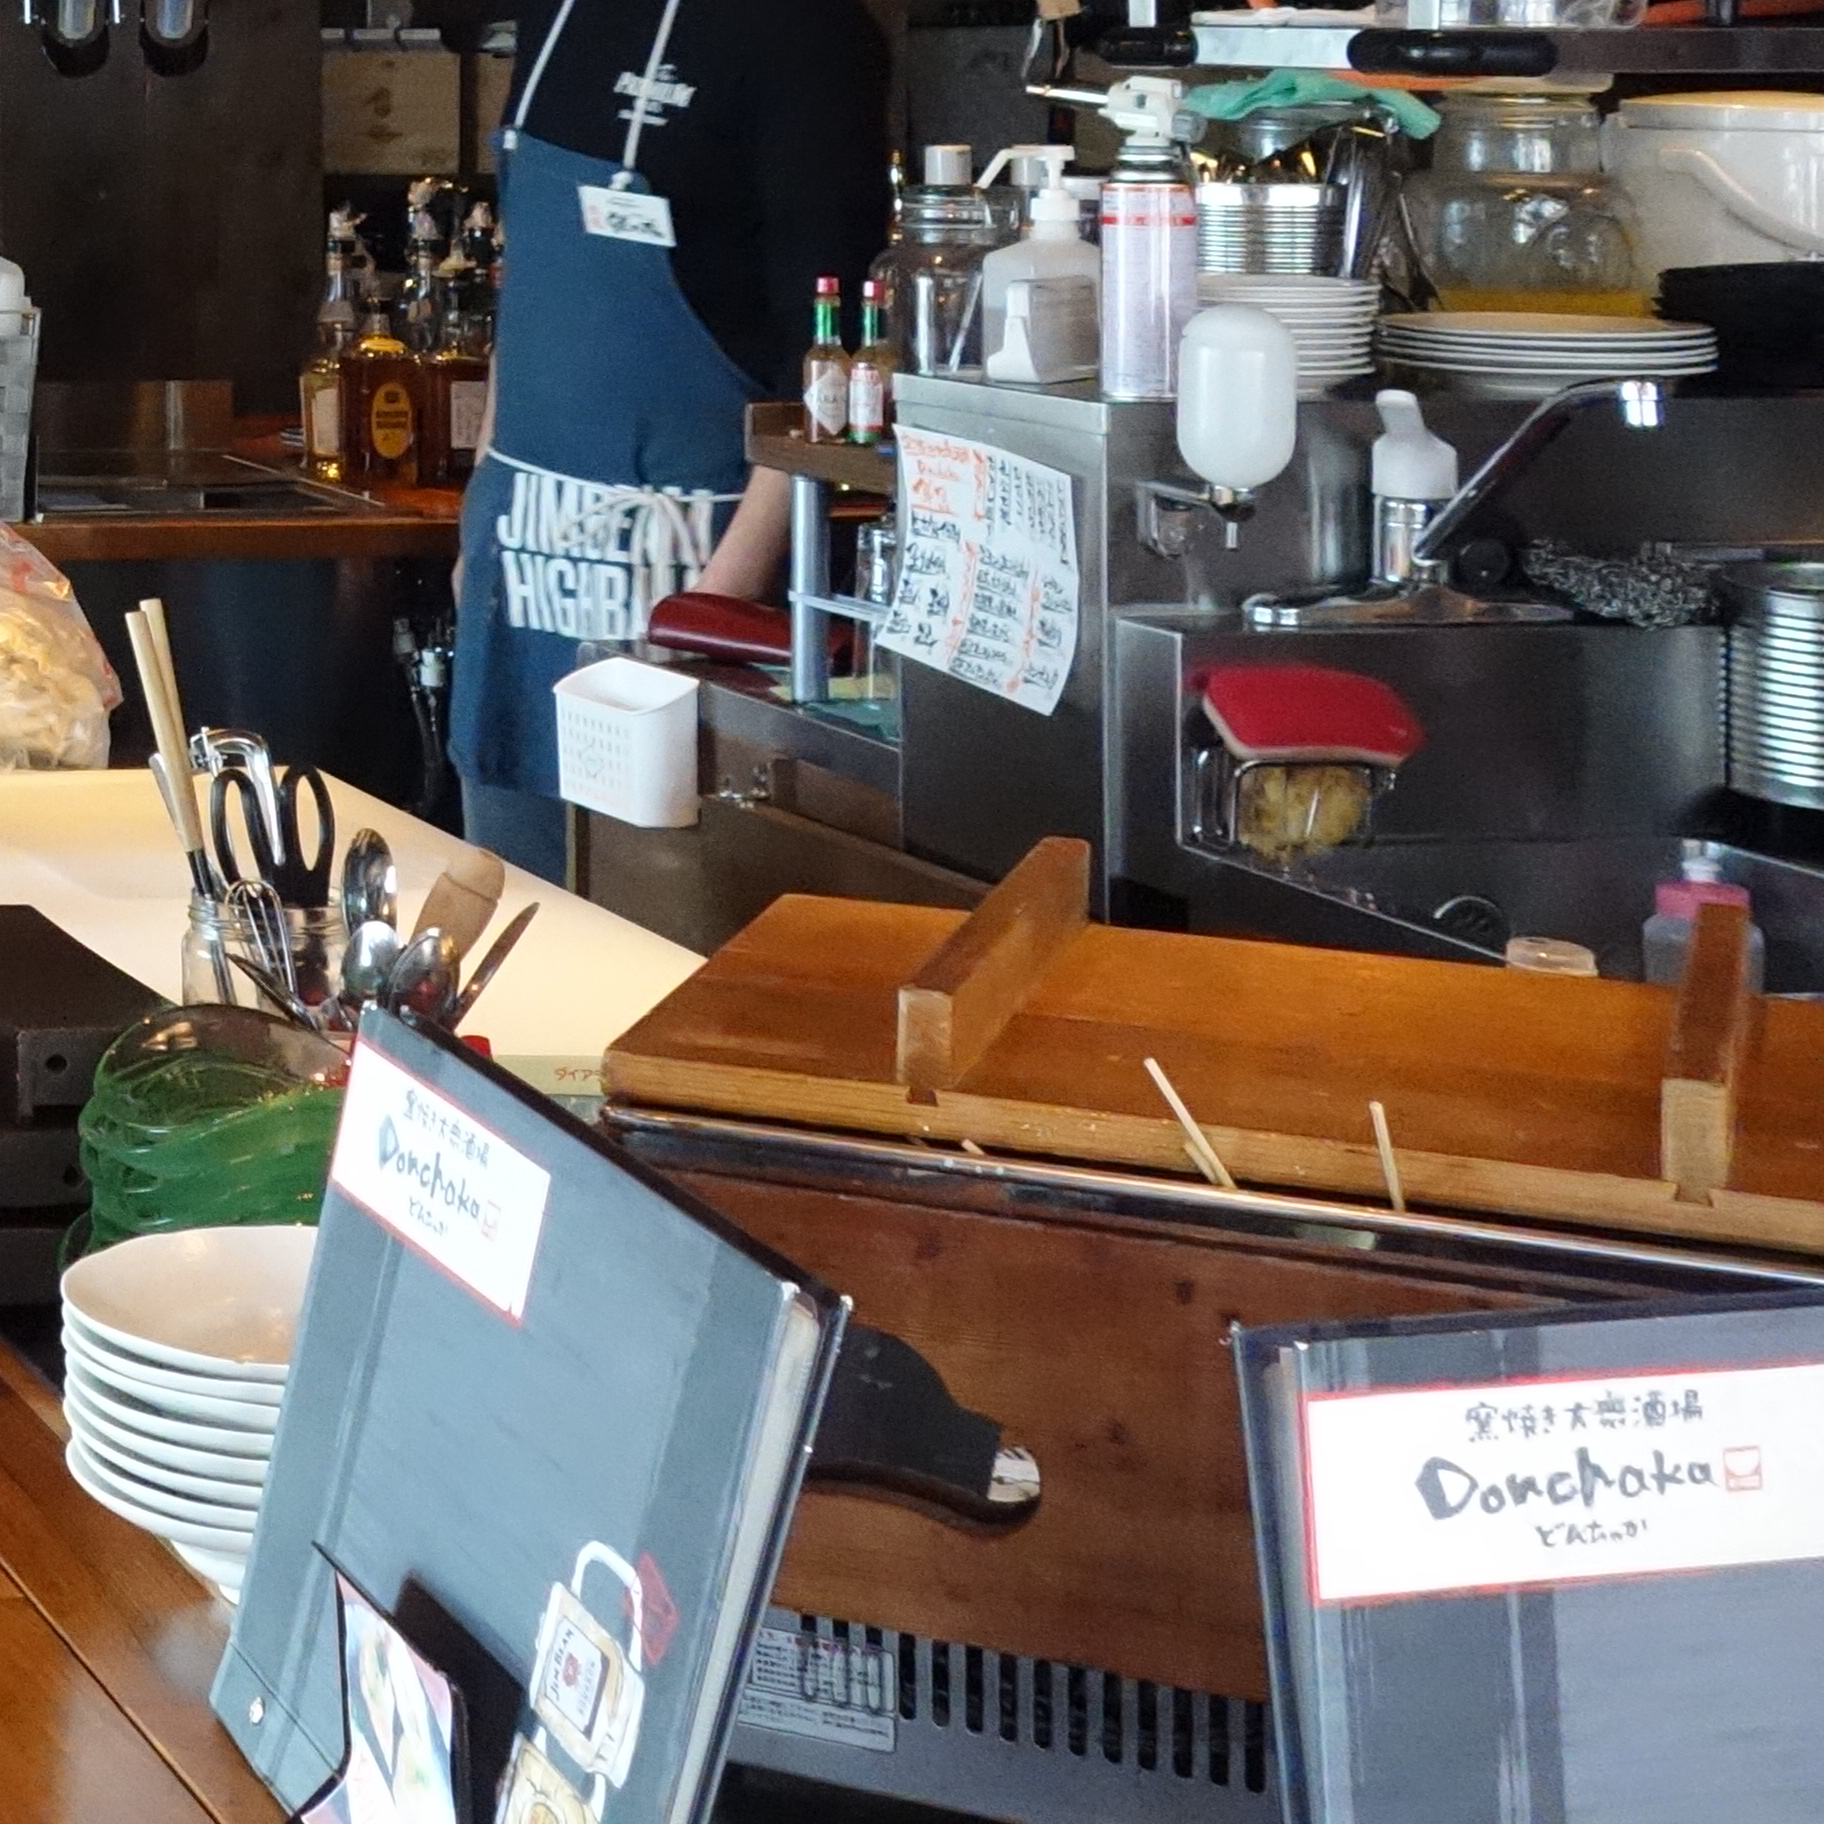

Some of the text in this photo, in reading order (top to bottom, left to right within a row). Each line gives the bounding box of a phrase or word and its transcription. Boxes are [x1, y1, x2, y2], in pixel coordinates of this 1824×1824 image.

[502, 549, 700, 642] HIGHB
[378, 1114, 480, 1219] Donchaka
[1415, 1446, 1720, 1520] Donchaka
